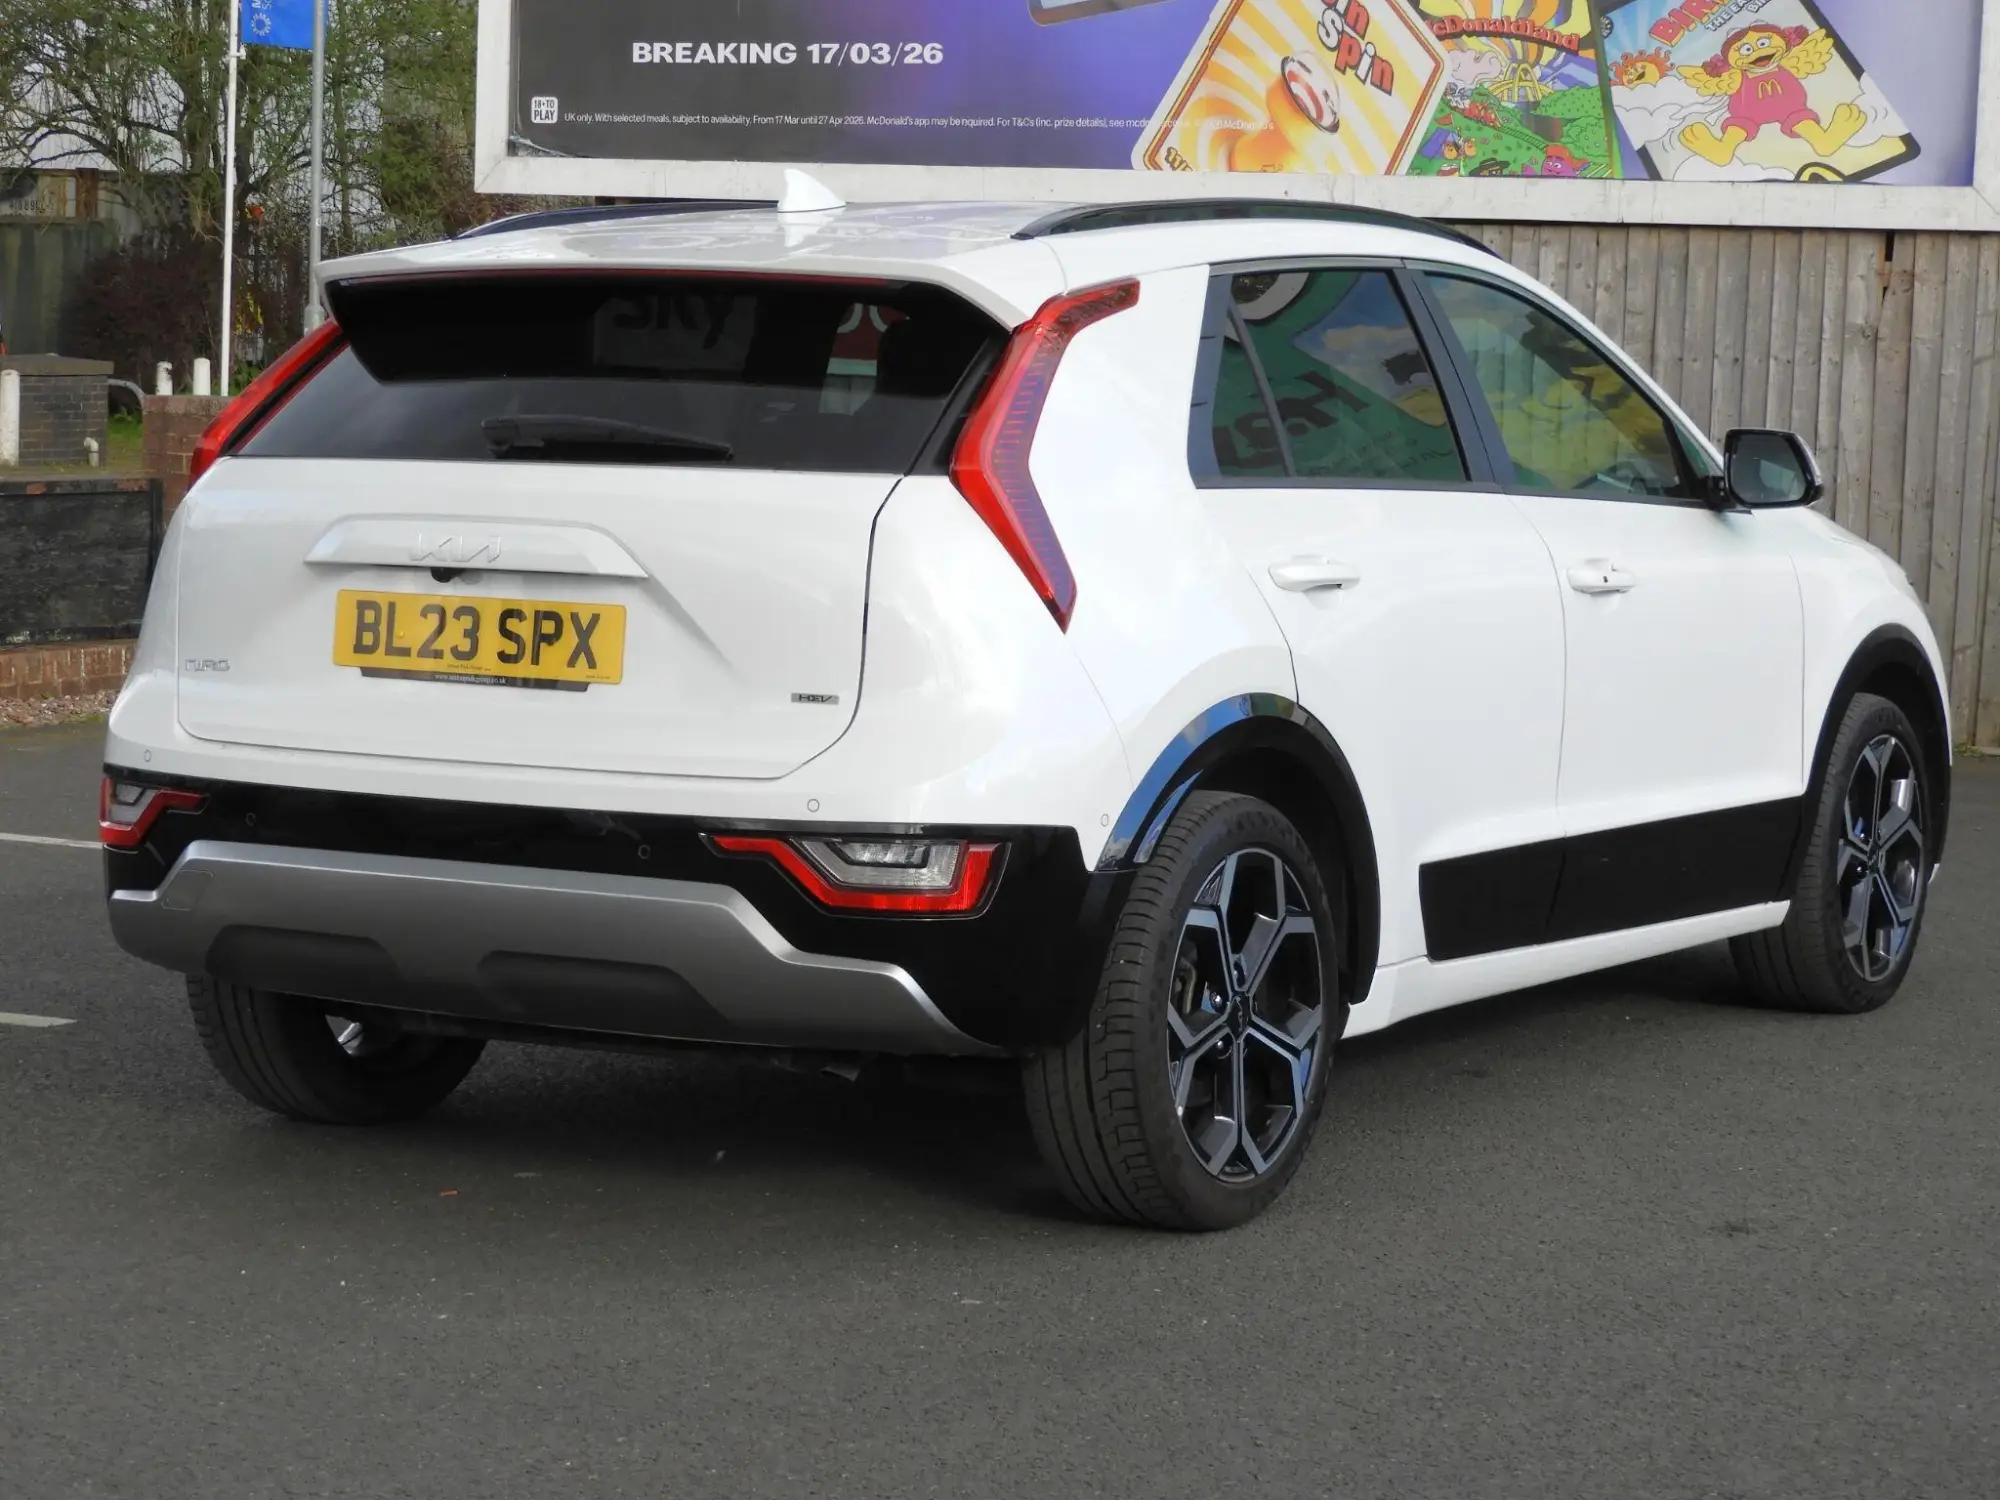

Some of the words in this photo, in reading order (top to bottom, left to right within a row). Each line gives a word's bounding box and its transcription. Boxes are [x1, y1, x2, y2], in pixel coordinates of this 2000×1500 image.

[1704, 11, 1733, 31] THE
[1424, 15, 1581, 53] cDonaldland
[632, 42, 797, 65] BREAKING
[806, 42, 943, 67] 17/03/26
[1316, 7, 1394, 96] Spin
[534, 109, 555, 121] PLAY
[564, 112, 576, 122] UK
[576, 112, 594, 125] only.
[594, 112, 613, 123] With
[613, 113, 646, 124] selected
[672, 113, 700, 126] subject
[701, 114, 709, 124] to
[753, 115, 774, 125] From
[775, 115, 783, 124] 17
[784, 115, 800, 125] Mar
[800, 115, 818, 125] until
[819, 116, 828, 125] 27
[829, 115, 843, 127] Apr
[867, 116, 913, 126] McDonald's
[914, 118, 930, 128] app
[931, 118, 948, 128] may
[950, 117, 961, 126] be
[997, 118, 1010, 127] For
[1012, 118, 1034, 127] T&Cs
[1054, 118, 1075, 129] prize
[1109, 120, 1124, 128] see
[353, 599, 480, 662] BL23
[496, 607, 601, 669] SPX
